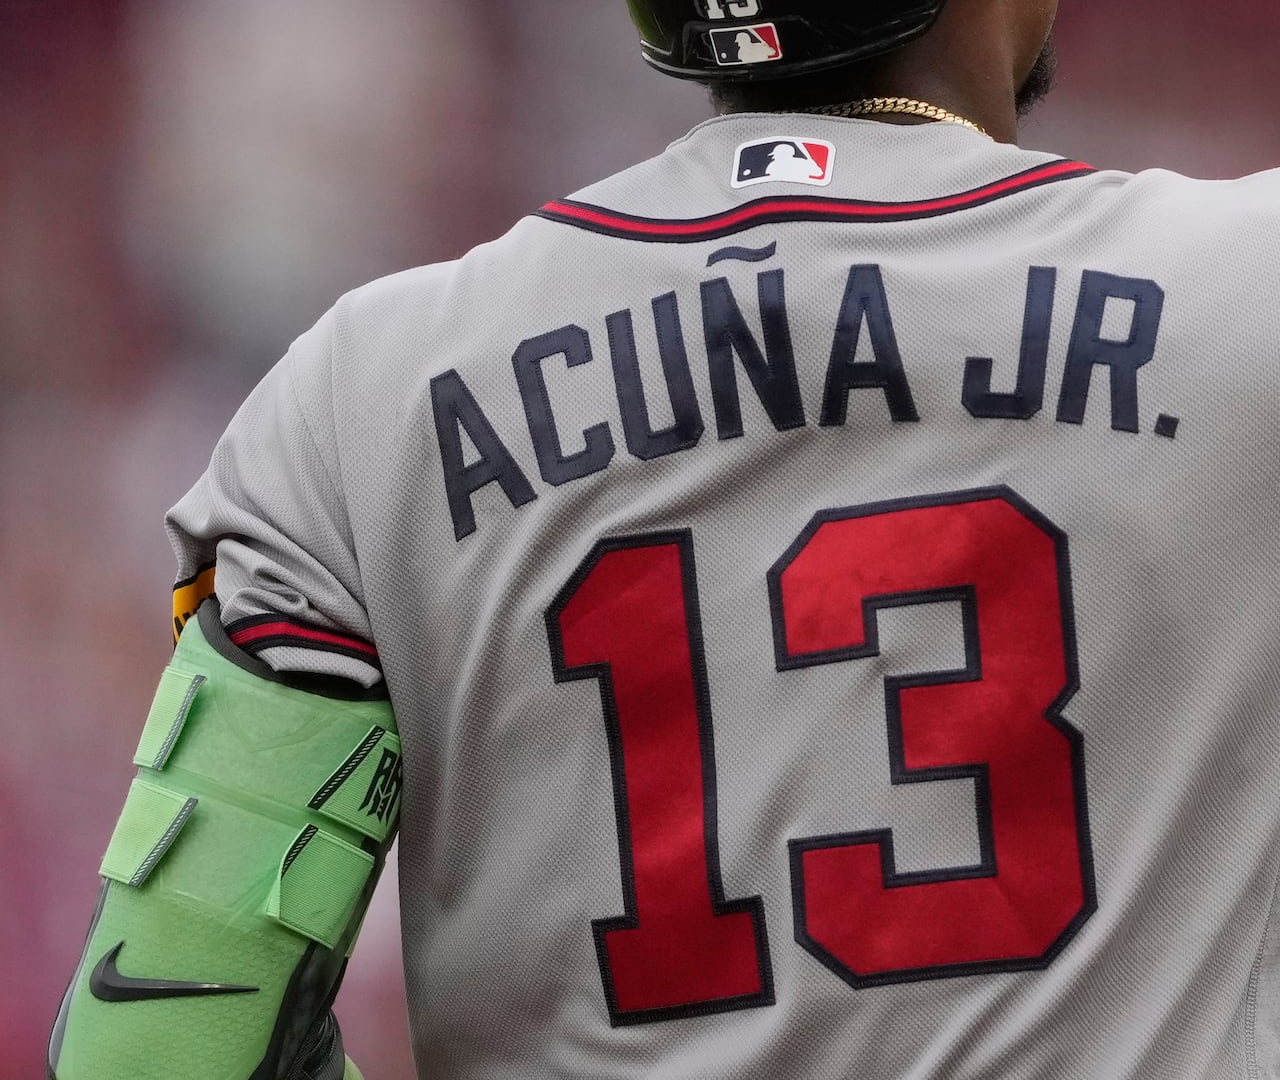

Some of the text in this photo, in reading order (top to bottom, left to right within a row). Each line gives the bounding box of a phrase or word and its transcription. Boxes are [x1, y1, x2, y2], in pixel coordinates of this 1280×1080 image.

[429, 241, 1180, 541] ACUÑA JR.
[544, 484, 1098, 1028] 13
